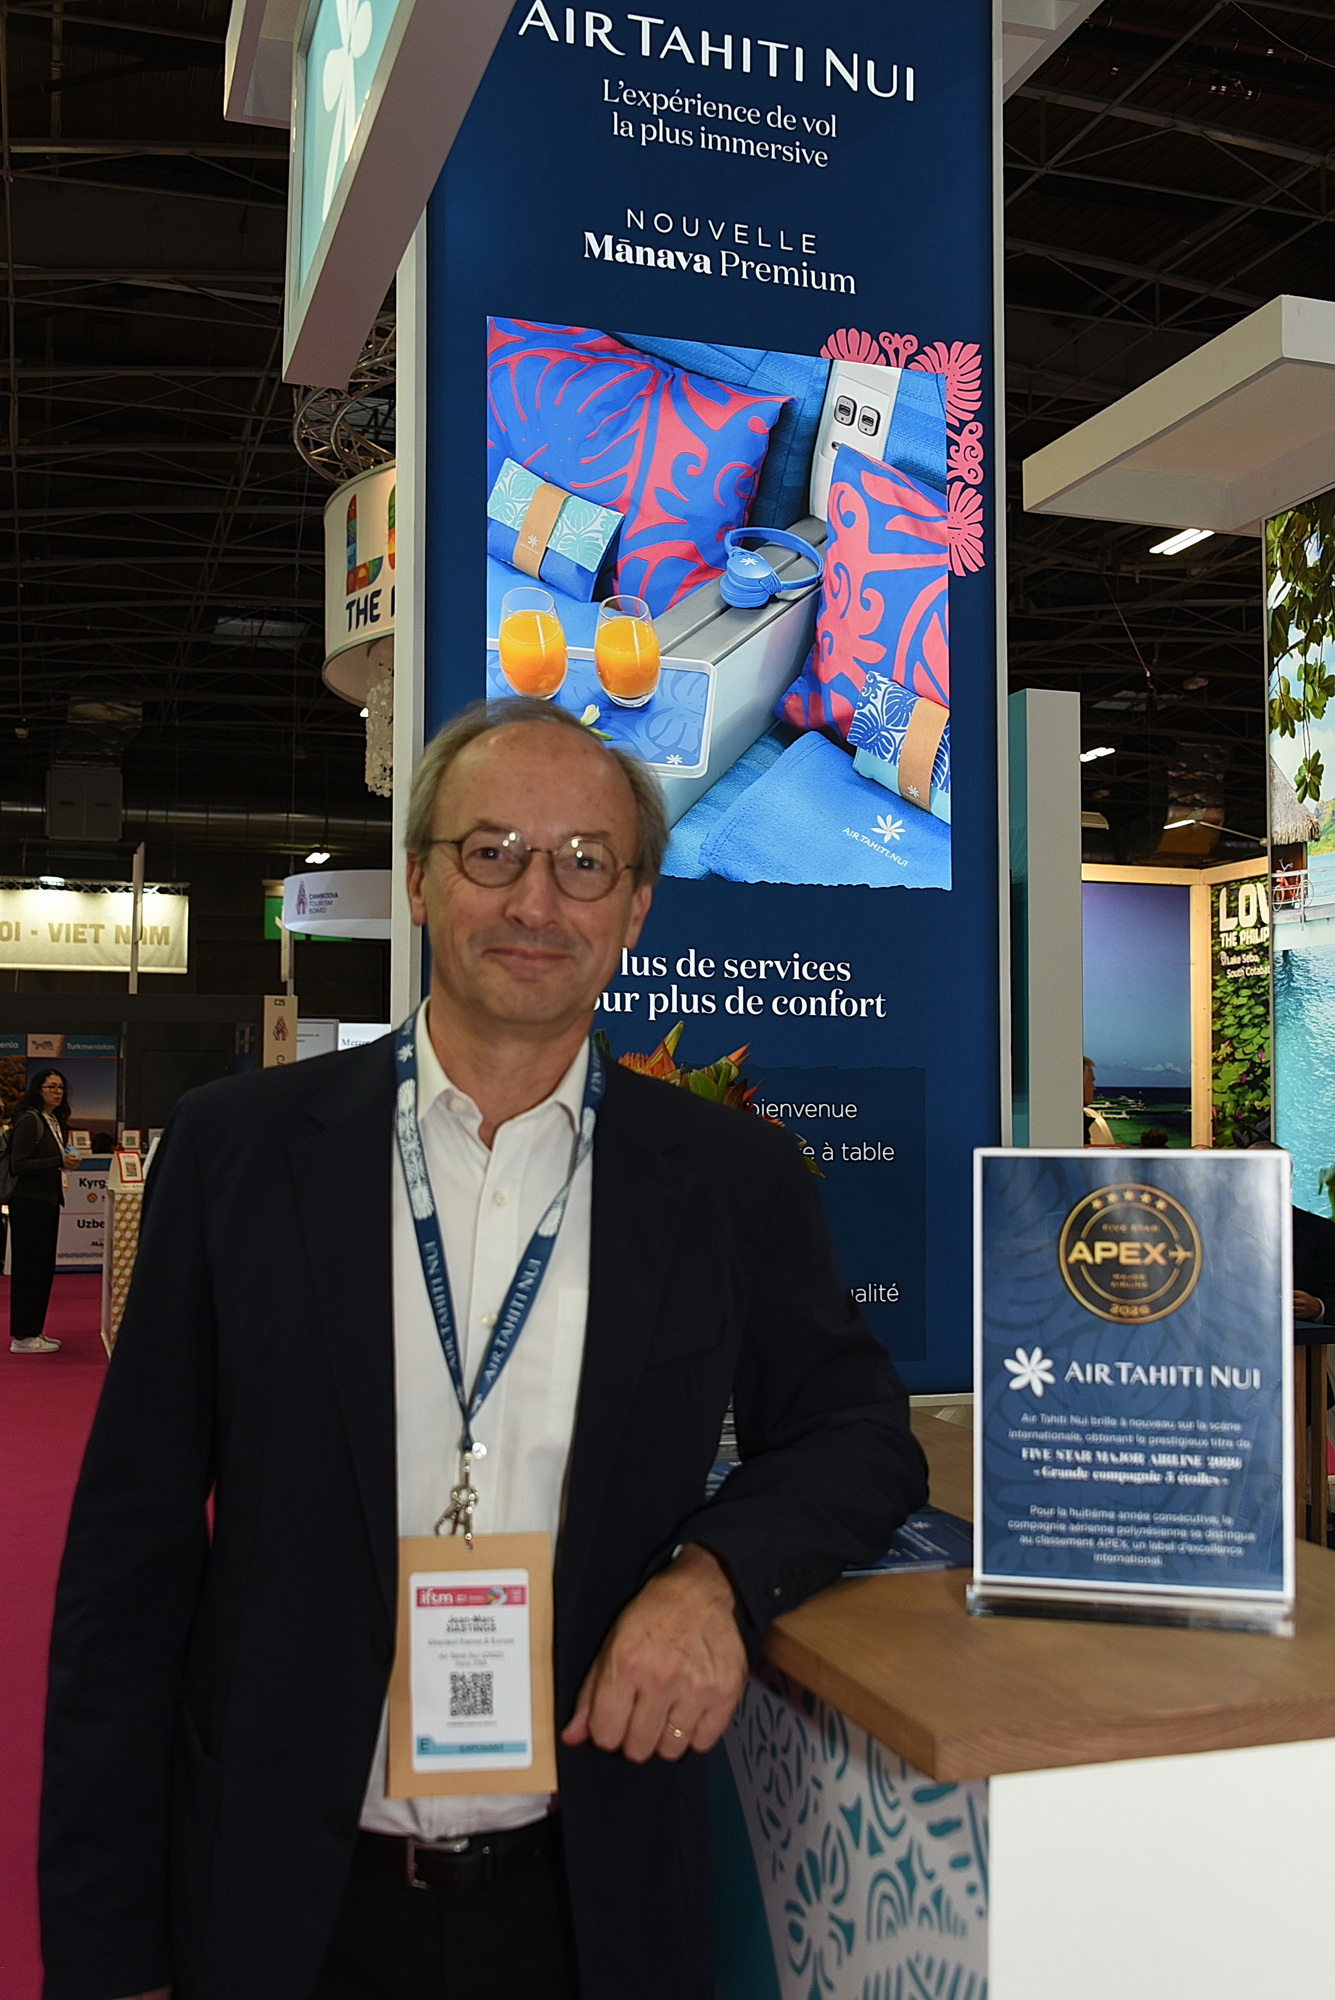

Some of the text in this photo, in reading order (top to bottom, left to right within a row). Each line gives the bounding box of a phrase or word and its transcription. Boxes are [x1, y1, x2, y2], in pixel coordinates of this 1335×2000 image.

[518, 0, 915, 102] AIR TAHITI NUI
[766, 103, 797, 132] de
[802, 113, 838, 138] vol
[612, 111, 829, 167] la plus immersive
[627, 209, 817, 255] NOUVELLE
[583, 231, 857, 295] Mānava Premium
[346, 588, 383, 632] THE
[308, 892, 339, 900] CAMBODIA
[48, 922, 105, 945] VIET
[1220, 931, 1238, 948] THE
[676, 949, 715, 978] de
[723, 952, 852, 982] services
[1227, 955, 1242, 965] Lake
[1227, 967, 1245, 979] South
[648, 984, 717, 1021] plus
[725, 985, 764, 1016] de
[771, 988, 887, 1019] confort
[67, 1043, 115, 1051] Turkmenistan
[821, 1142, 834, 1161] à
[841, 1141, 895, 1161] table
[1064, 1360, 1261, 1390] AIR TAHITI NUI
[1021, 1412, 1038, 1424] Air
[1040, 1413, 1067, 1425] Tahiti
[1069, 1414, 1088, 1426] Nui
[1129, 1418, 1176, 1430] nouveau
[1177, 1420, 1195, 1431] sur
[1085, 1432, 1135, 1445] obtenant
[1021, 1447, 1053, 1462] FIVE
[1055, 1448, 1093, 1464] STAR
[1029, 1505, 1056, 1518] Pour
[1057, 1506, 1068, 1519] la
[1069, 1507, 1116, 1521] huitième
[1007, 1520, 1067, 1534] compagnie
[1019, 1535, 1034, 1546] au
